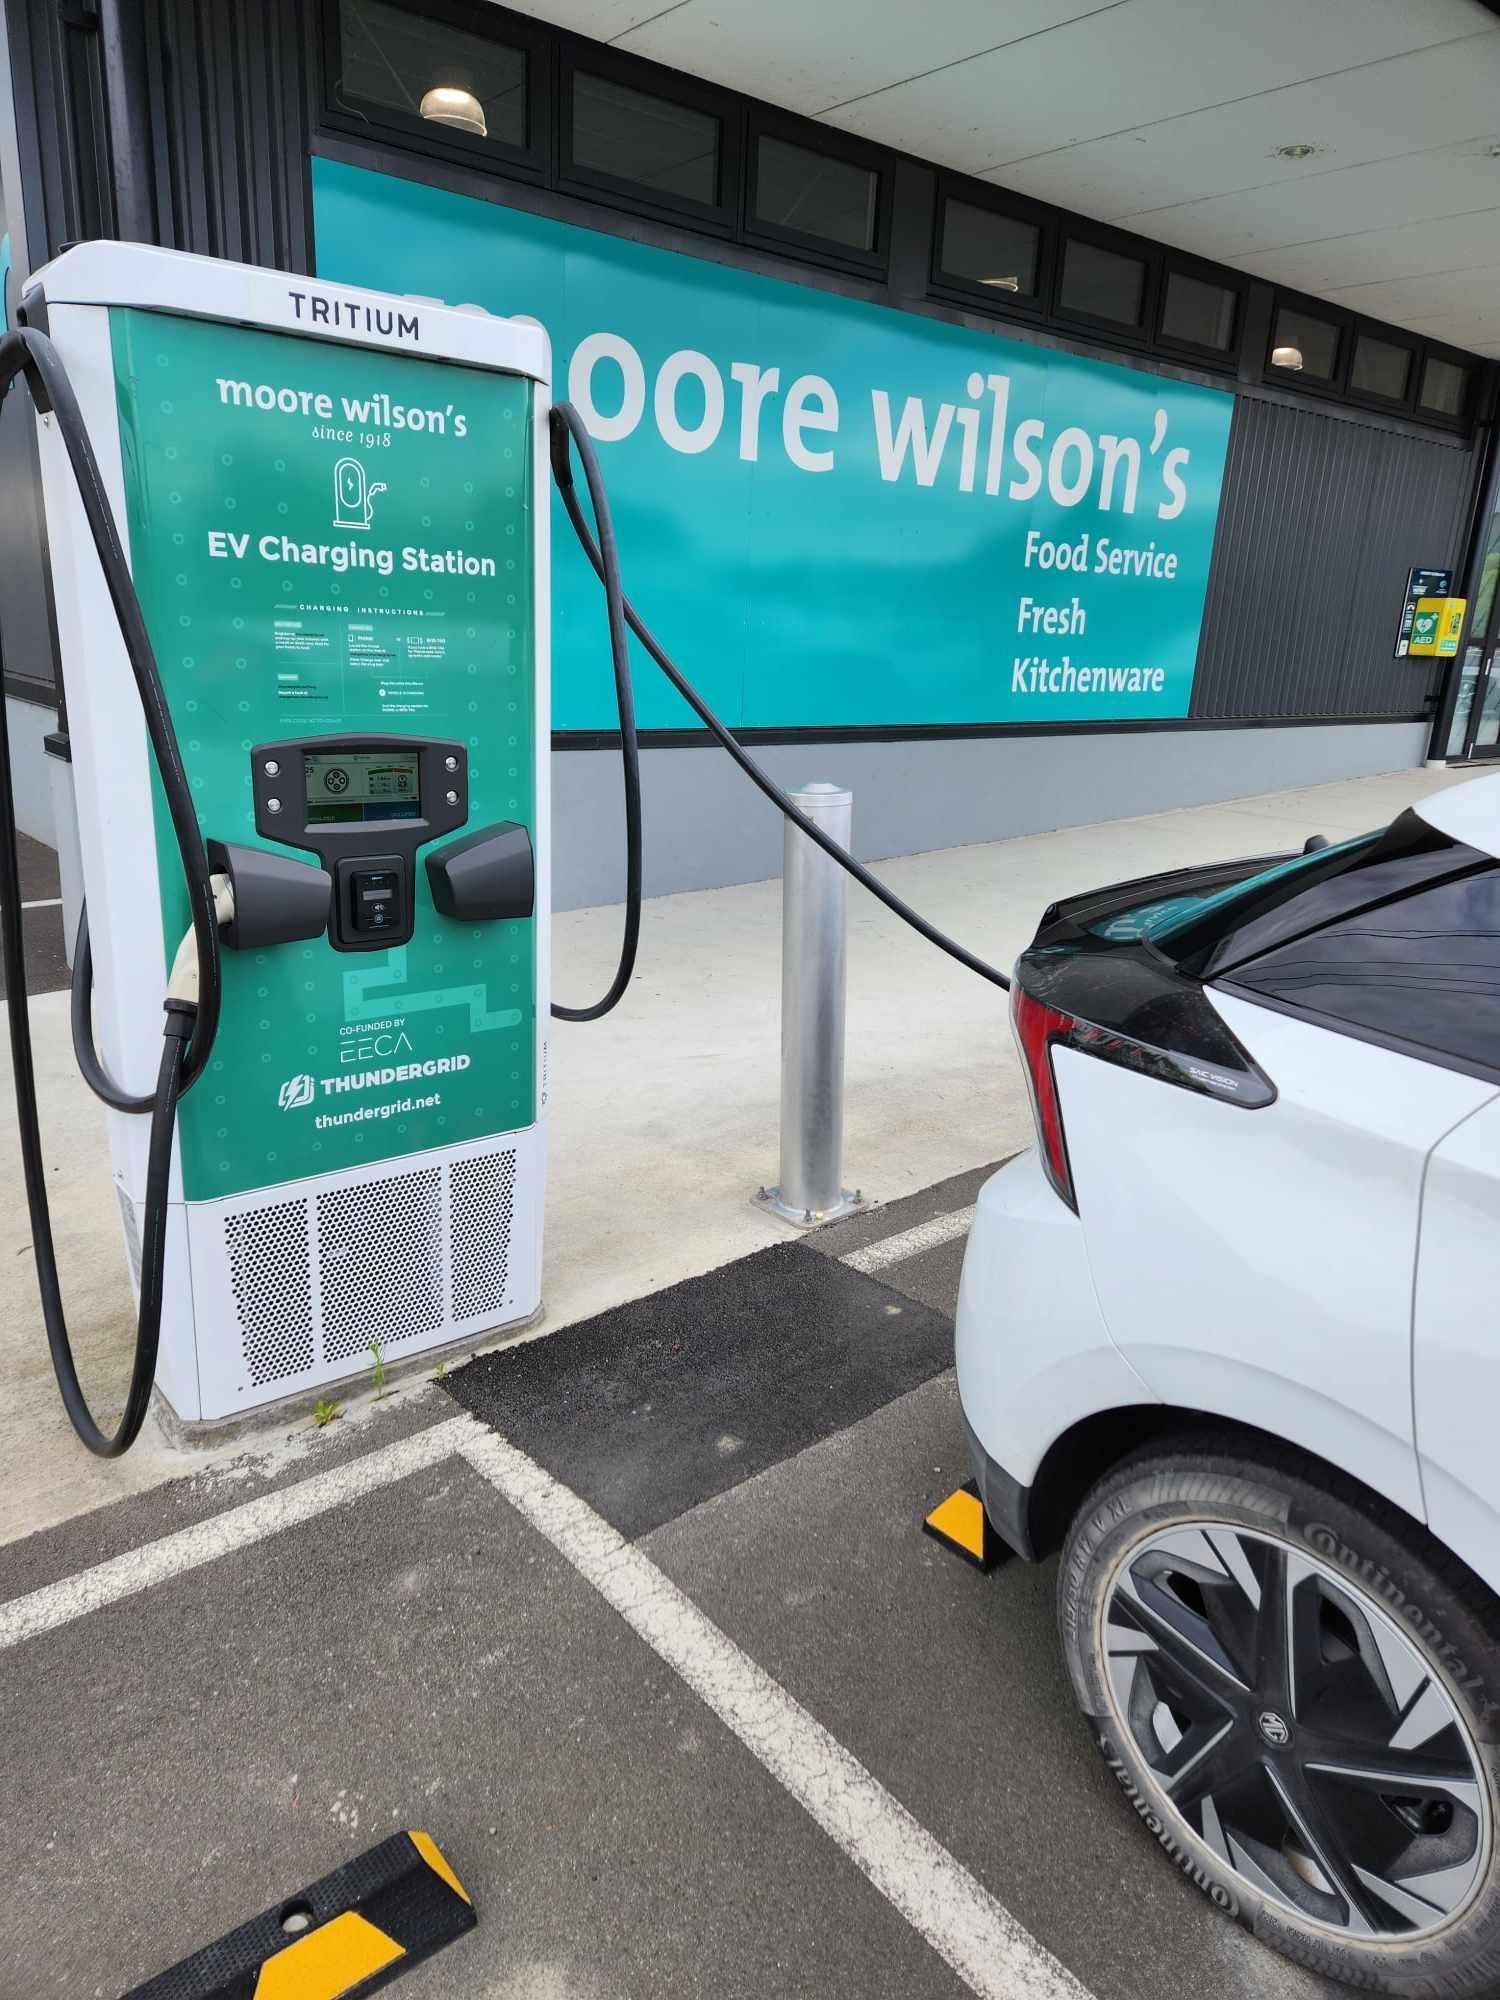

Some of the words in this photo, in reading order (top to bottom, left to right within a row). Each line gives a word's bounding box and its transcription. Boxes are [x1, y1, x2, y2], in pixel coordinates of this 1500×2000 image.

[289, 291, 420, 341] TRITIUM
[215, 377, 333, 419] moore
[341, 393, 468, 438] wilson's
[568, 332, 840, 473] oore
[871, 372, 1190, 521] wilson's
[311, 424, 353, 444] since
[359, 432, 392, 449] 1918
[207, 531, 250, 560] EV
[258, 536, 394, 576] Charging
[402, 546, 497, 577] Station
[1024, 530, 1088, 574] Food
[1094, 536, 1179, 580] Service
[299, 603, 349, 613] CHARGING
[357, 607, 424, 617] INSTRUCTIONS
[1017, 597, 1087, 636] Fresh
[1011, 657, 1165, 694] Kitchenware
[339, 1020, 392, 1036] CO-FUNDED
[393, 1018, 406, 1029] BY
[340, 1032, 413, 1063] EECA
[320, 1054, 471, 1096] THUNDERGRID
[314, 1092, 441, 1130] thundergrid.net
